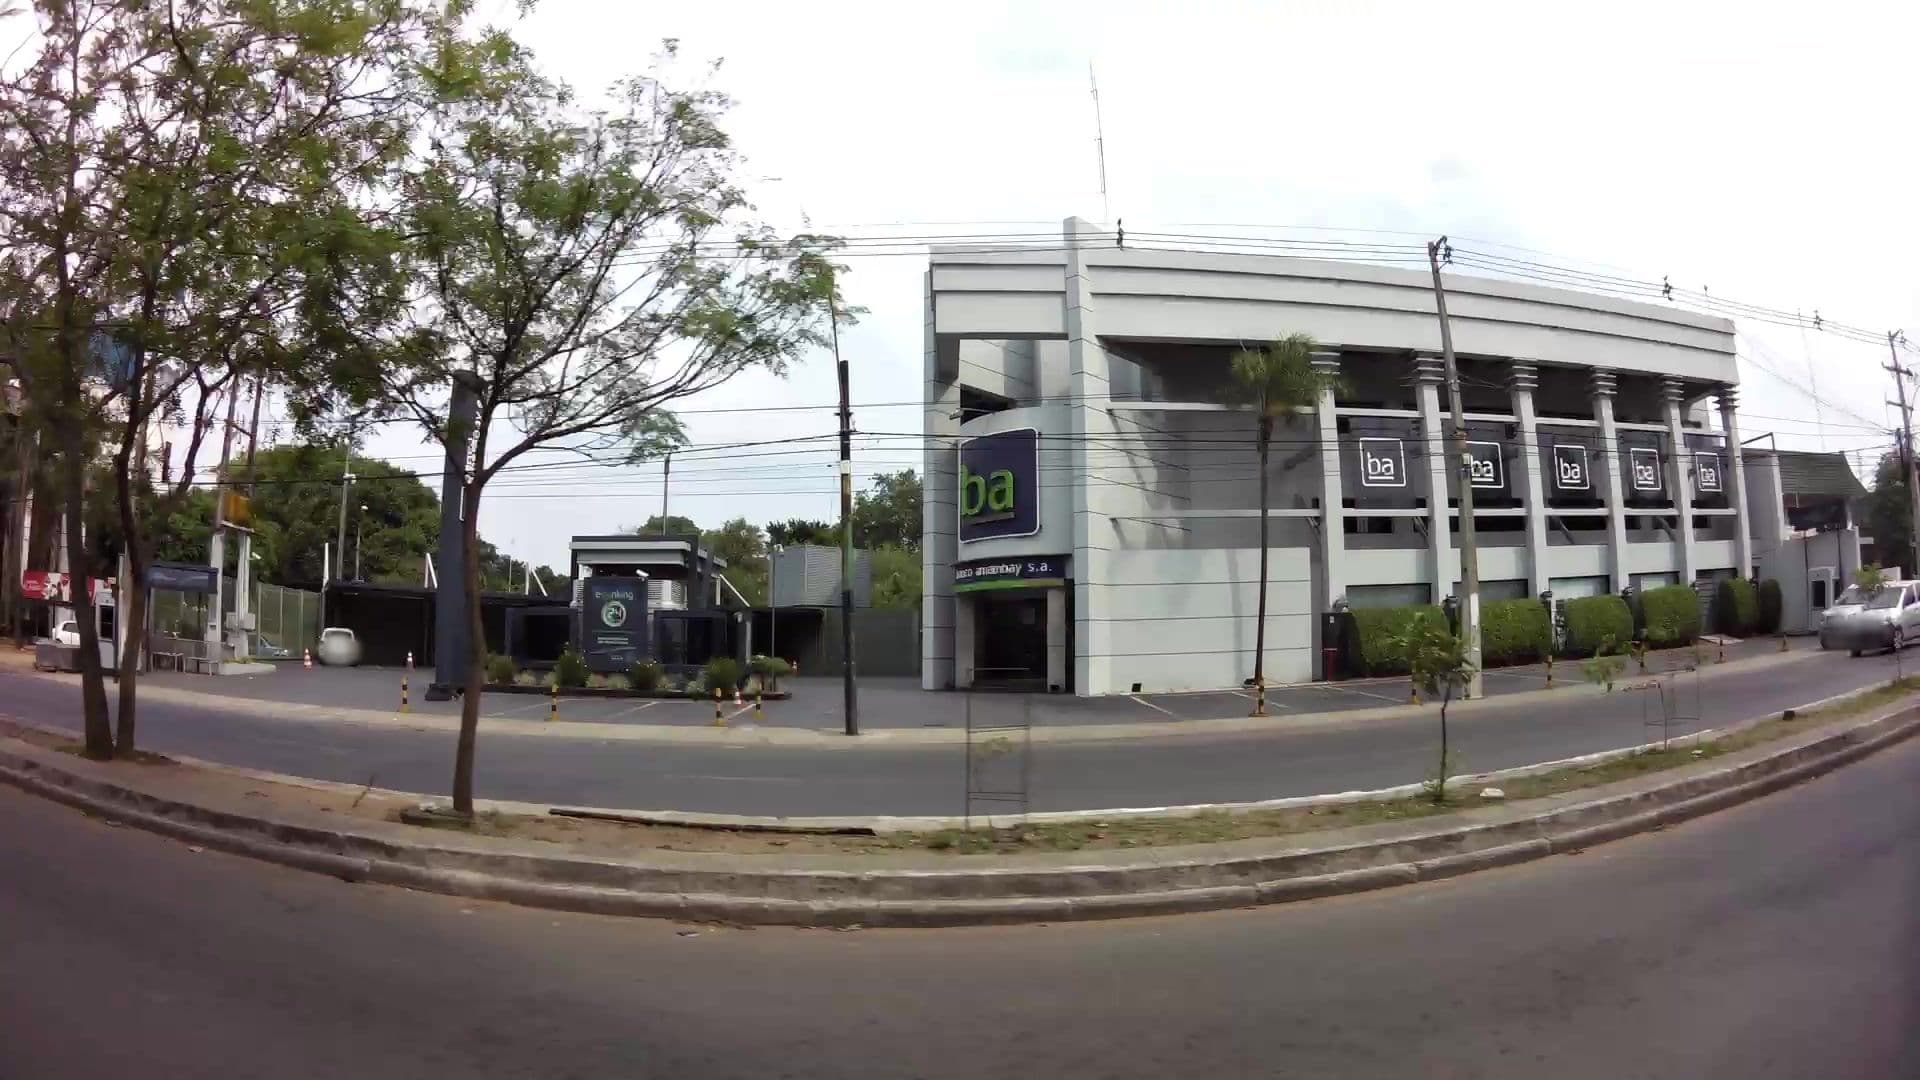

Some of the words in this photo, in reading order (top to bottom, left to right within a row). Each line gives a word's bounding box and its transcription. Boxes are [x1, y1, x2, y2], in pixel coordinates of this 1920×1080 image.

[1367, 452, 1394, 475] ba
[1471, 455, 1493, 477] ba
[1560, 457, 1581, 479] ba
[1635, 460, 1654, 481] ba
[1700, 463, 1716, 482] ba
[960, 464, 1013, 515] ba
